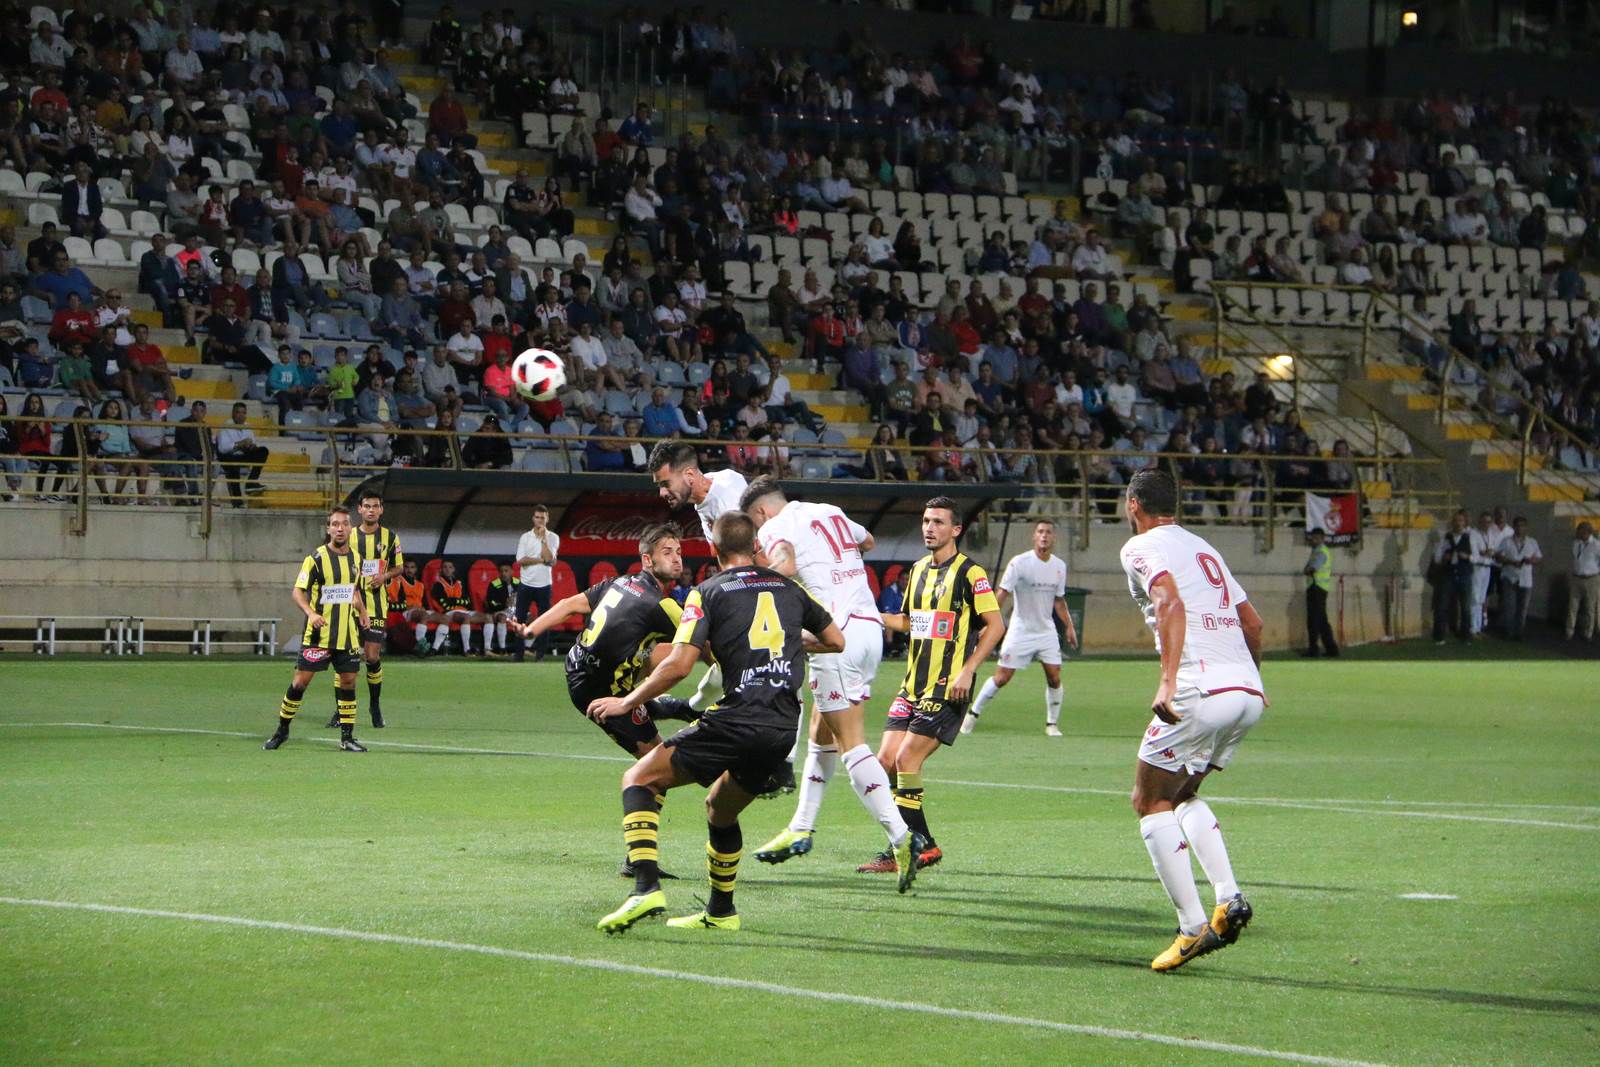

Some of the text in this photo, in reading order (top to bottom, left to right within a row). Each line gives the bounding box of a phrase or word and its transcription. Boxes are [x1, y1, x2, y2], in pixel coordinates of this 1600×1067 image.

[1196, 552, 1230, 610] 9
[580, 588, 624, 647] 5
[748, 592, 785, 661] 4
